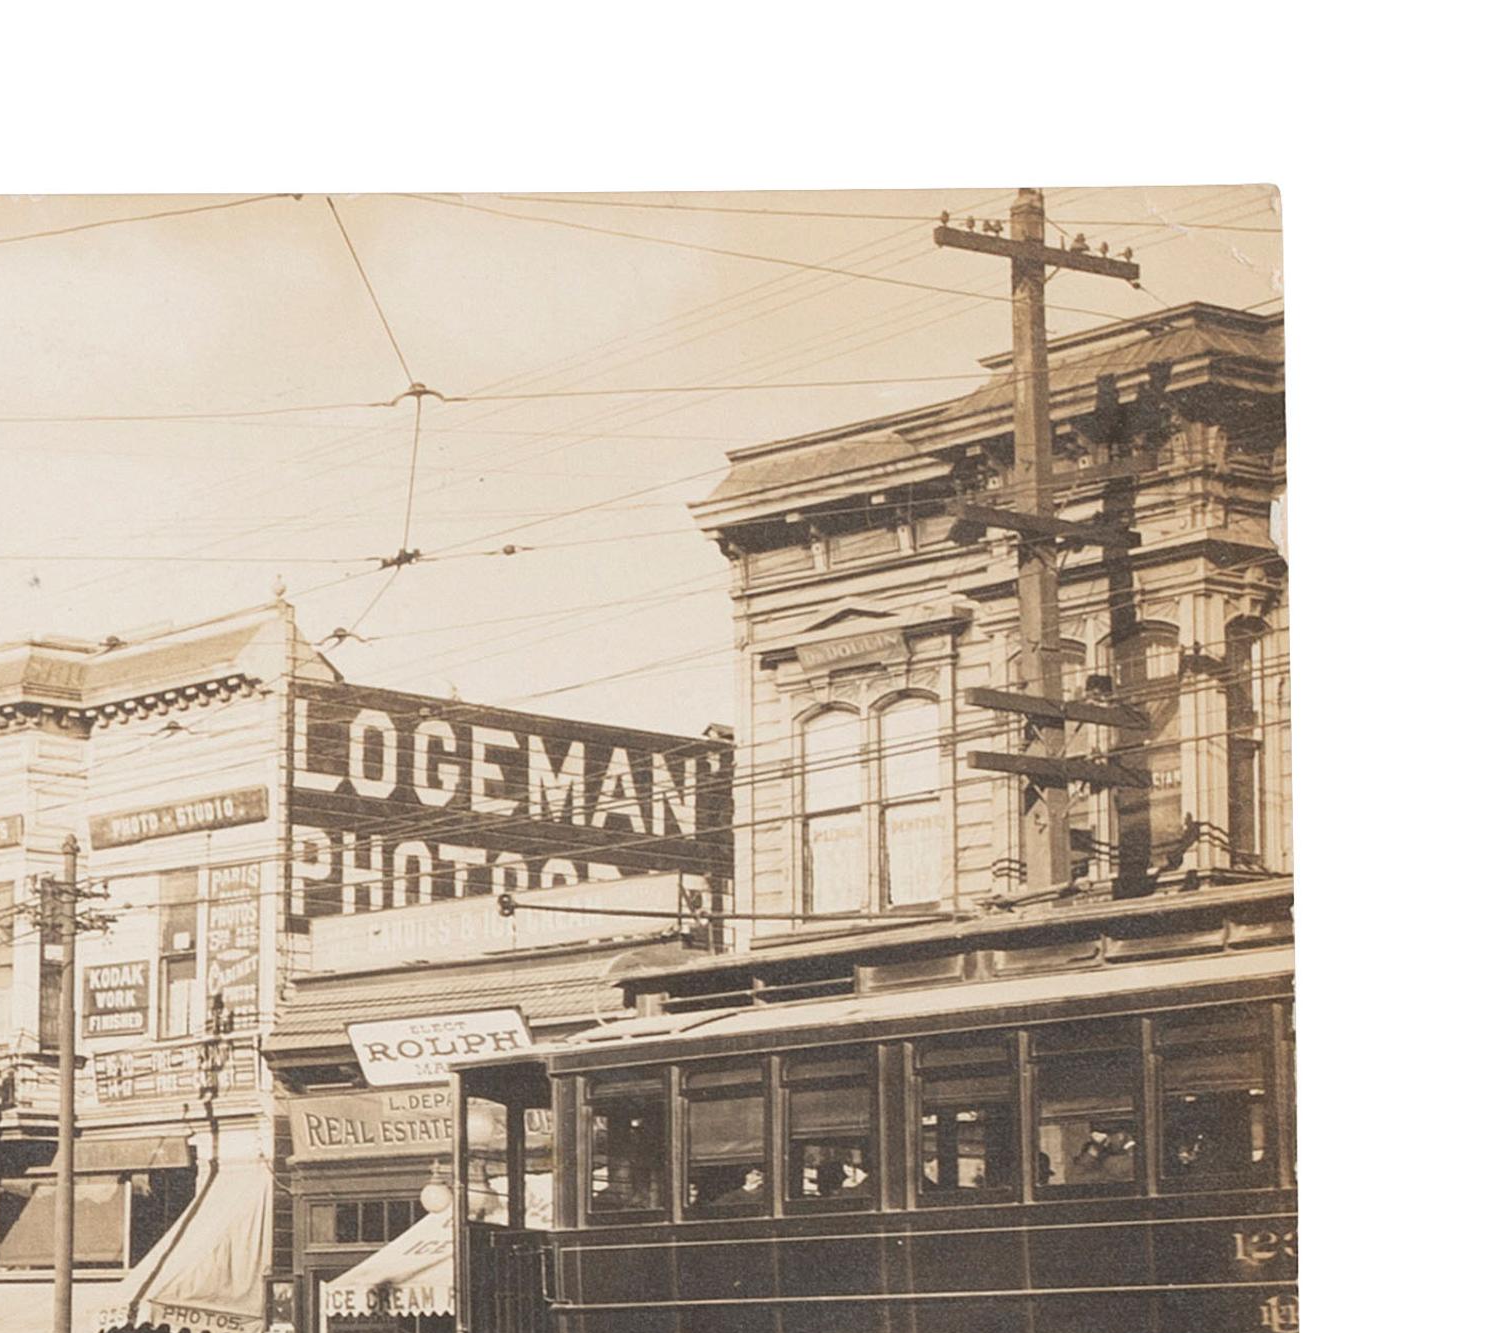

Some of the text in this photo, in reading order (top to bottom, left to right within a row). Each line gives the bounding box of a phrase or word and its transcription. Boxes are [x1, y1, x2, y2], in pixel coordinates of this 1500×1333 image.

[111, 813, 159, 838] PHOTO
[88, 963, 145, 990] KODAK
[94, 989, 137, 1009] WORK
[88, 1011, 144, 1033] FINISHED
[409, 1021, 467, 1034] ELECT
[362, 1028, 520, 1063] ROLPH
[303, 1111, 453, 1149] REAL ESTATE
[324, 1288, 356, 1311] ICE
[365, 1286, 435, 1311] CREAM
